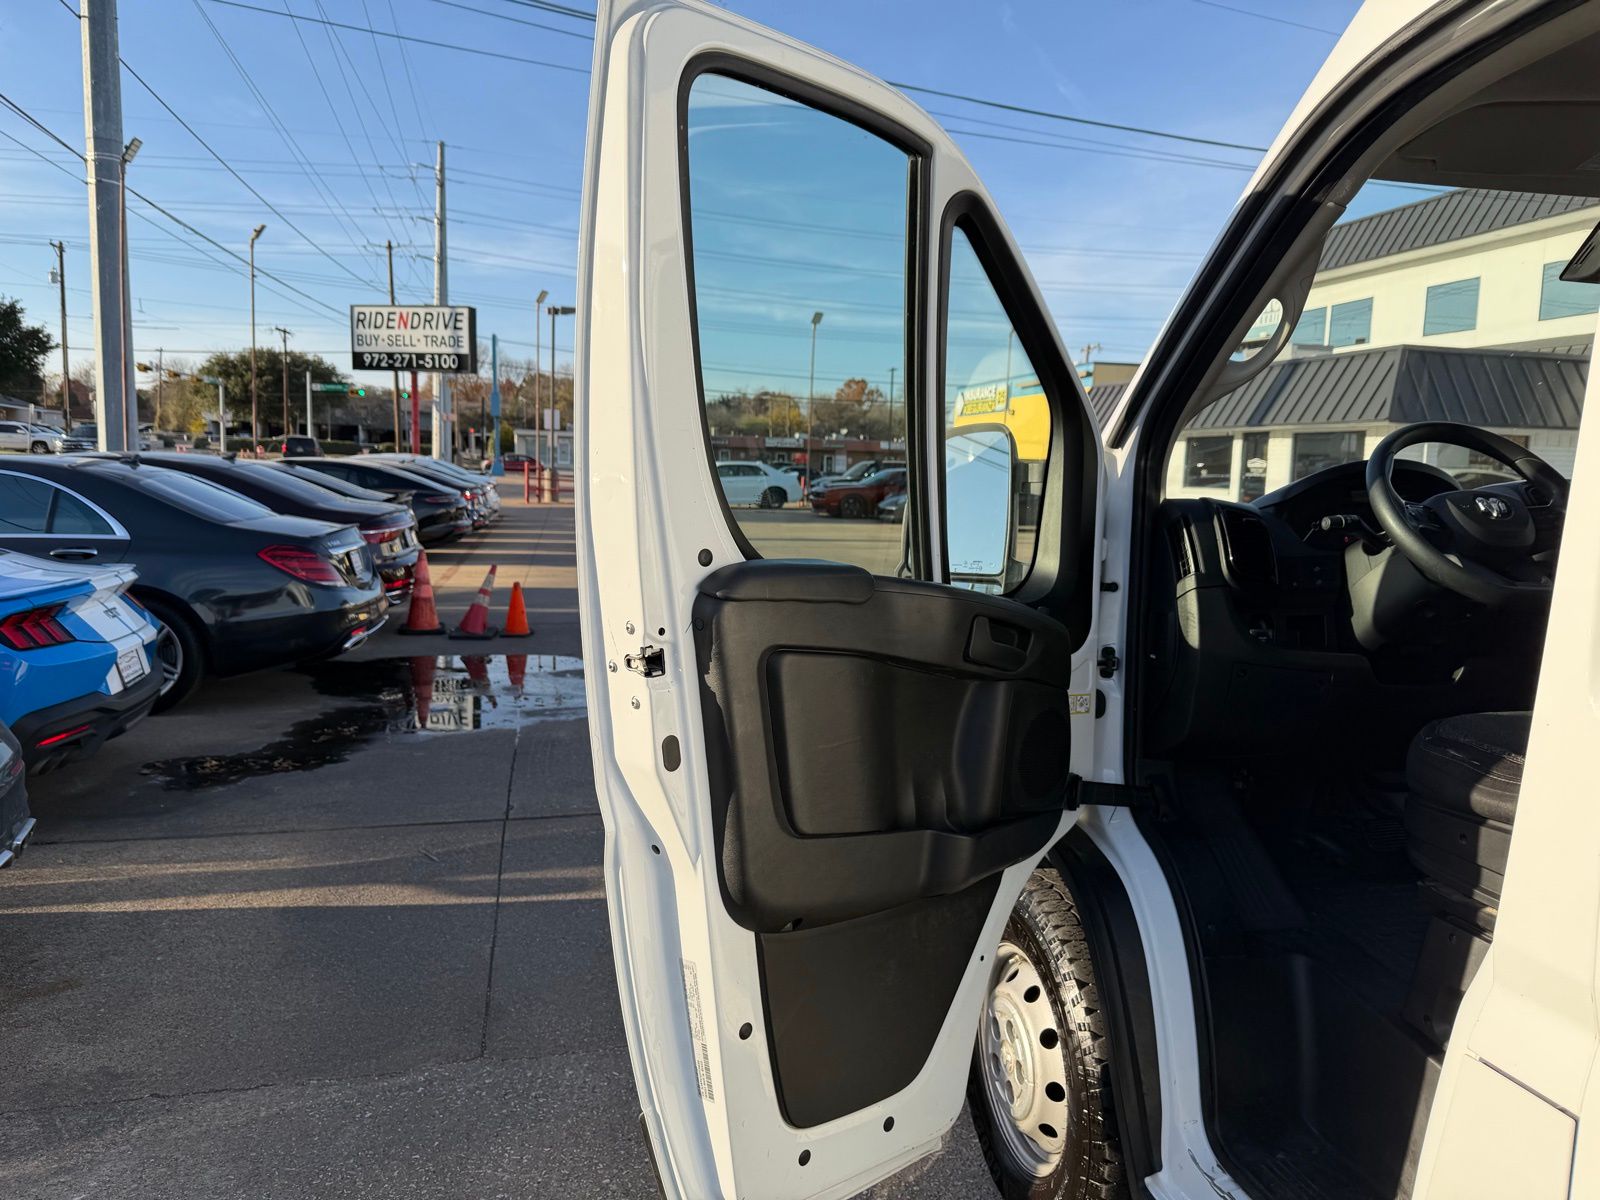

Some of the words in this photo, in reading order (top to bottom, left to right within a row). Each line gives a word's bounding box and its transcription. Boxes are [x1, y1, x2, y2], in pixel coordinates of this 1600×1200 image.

[356, 311, 465, 331] RIDENDRIVE
[356, 334, 380, 347] BUY
[386, 335, 417, 348] SELL
[423, 335, 465, 348] TRADE
[363, 353, 459, 369] 972-271-5100
